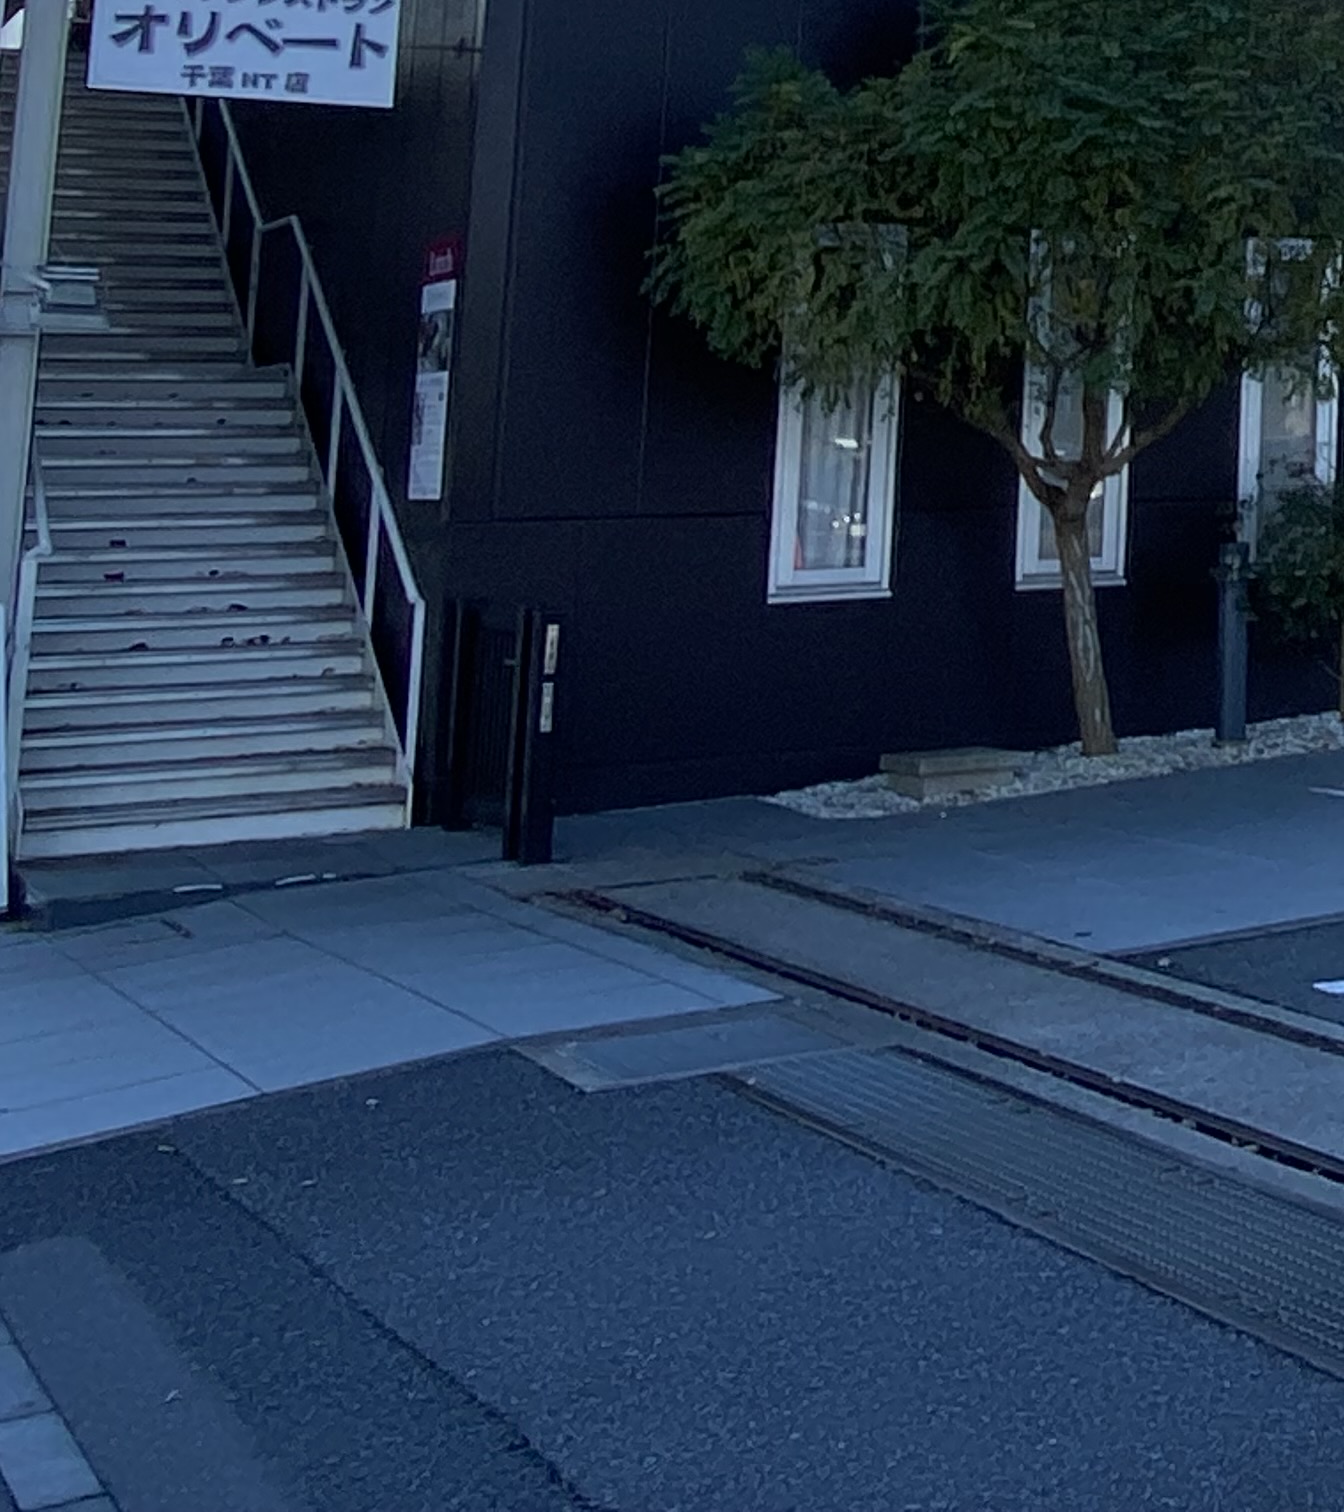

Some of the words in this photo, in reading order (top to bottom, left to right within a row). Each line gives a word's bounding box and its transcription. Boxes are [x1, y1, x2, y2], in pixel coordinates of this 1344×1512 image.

[108, 3, 391, 70] オリベート
